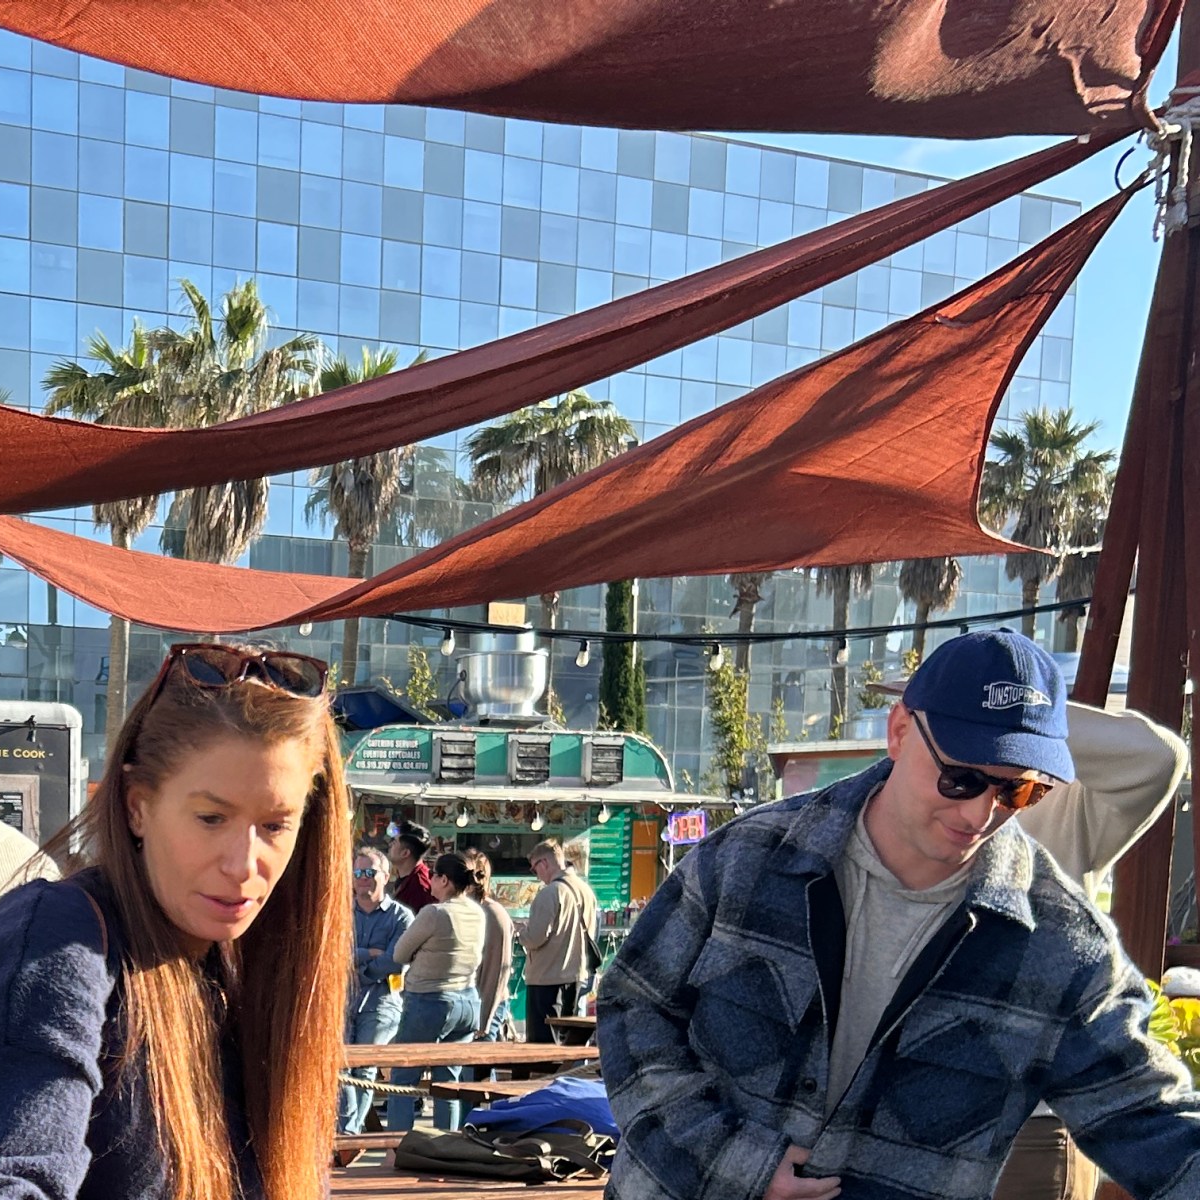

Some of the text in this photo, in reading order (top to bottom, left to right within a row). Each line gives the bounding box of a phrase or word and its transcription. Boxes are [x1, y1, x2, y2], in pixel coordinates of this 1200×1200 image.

[991, 686, 1043, 706] UNSTOPP
[367, 739, 419, 749] CATERING SERVICE
[13, 748, 46, 759] COOK
[362, 749, 421, 759] EVENTOS ESPECIALES
[672, 815, 704, 840] OPEN
